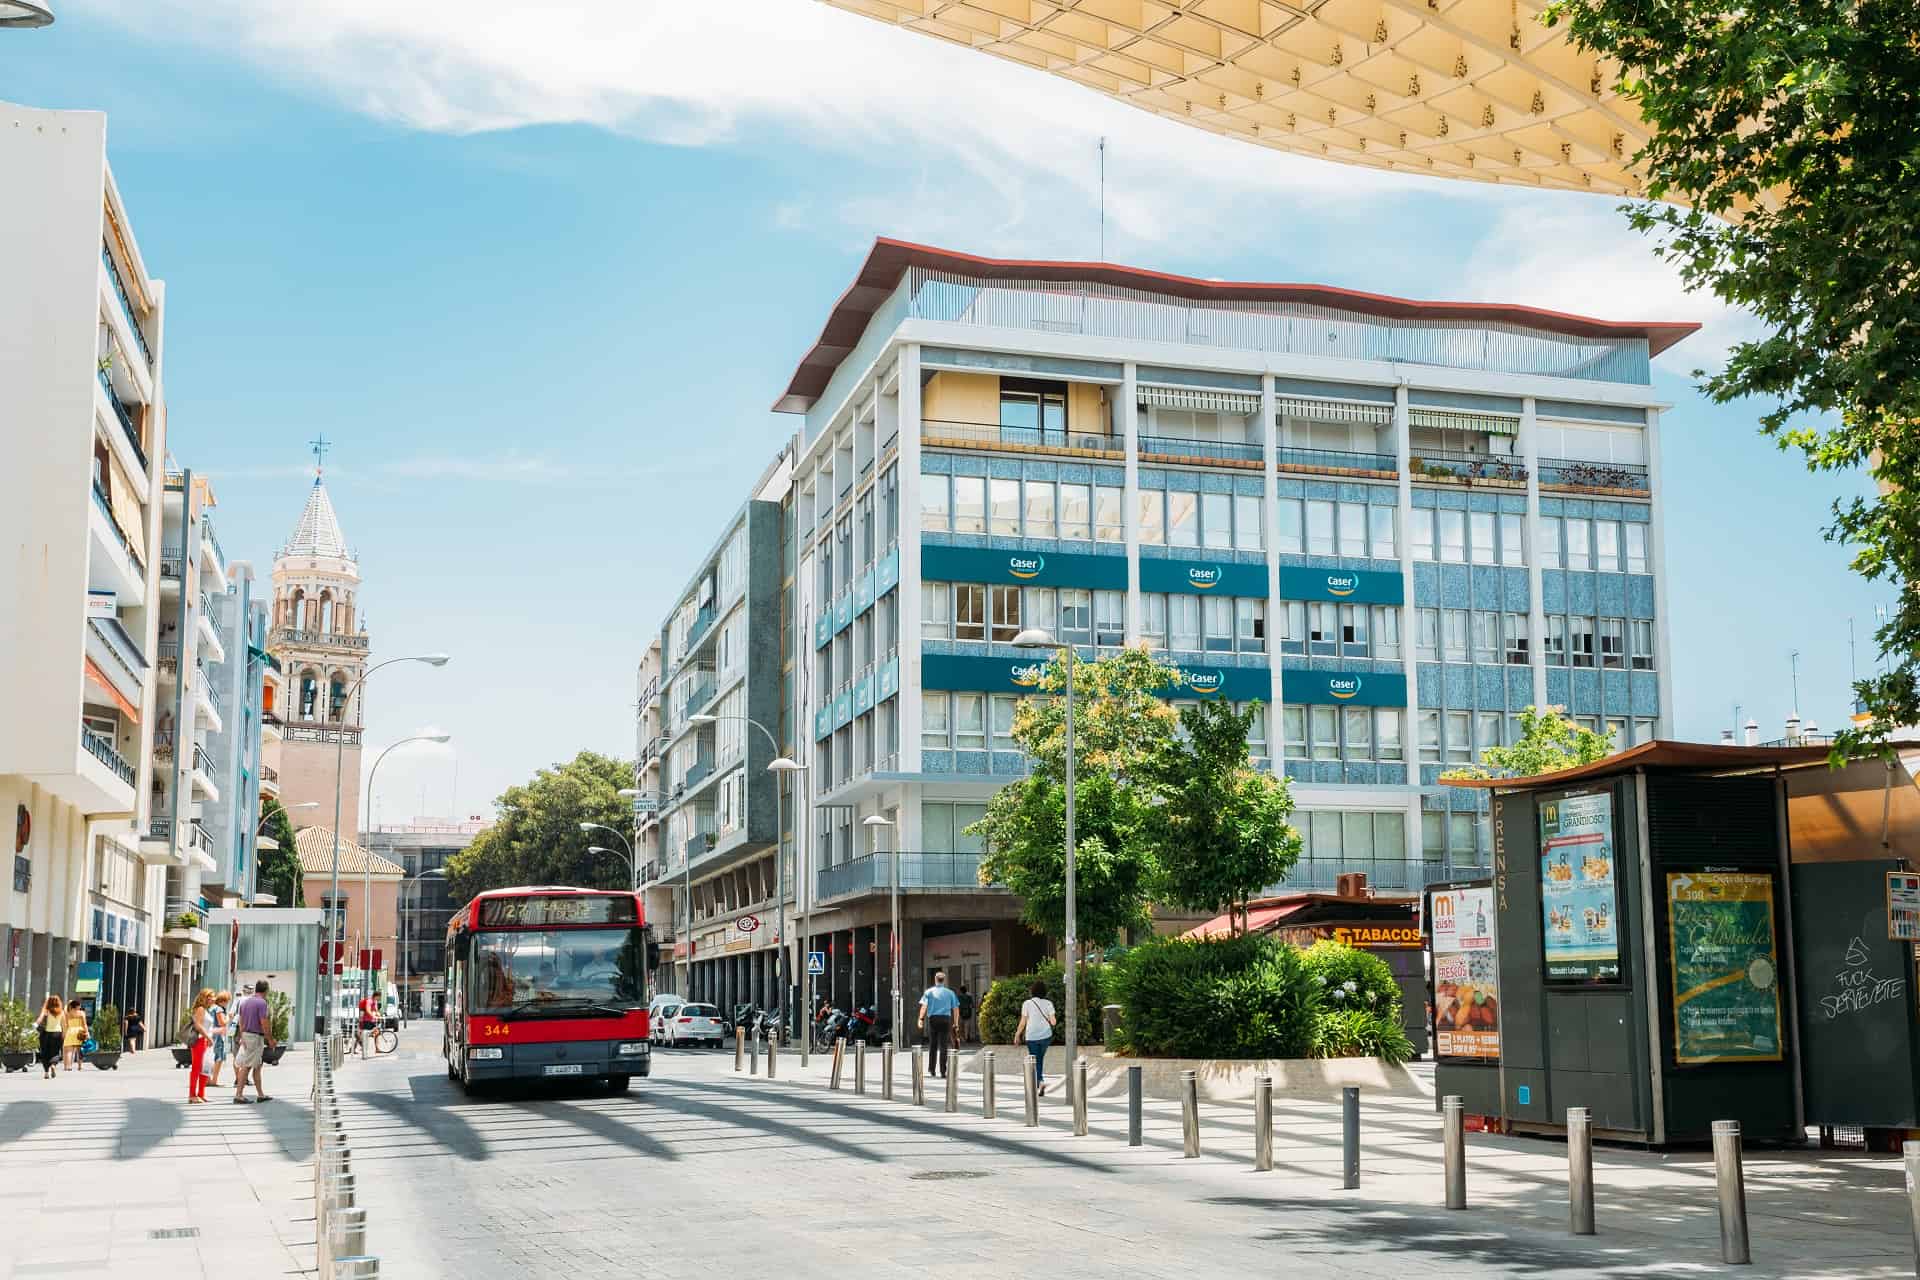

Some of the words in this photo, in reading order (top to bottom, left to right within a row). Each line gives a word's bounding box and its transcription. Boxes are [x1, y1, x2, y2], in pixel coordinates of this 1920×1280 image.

[1010, 557, 1037, 569] Caser
[1189, 568, 1215, 578] Caser
[1327, 576, 1352, 586] Caser
[1191, 673, 1217, 683] Caser
[1330, 679, 1355, 689] Caser
[1494, 800, 1508, 912] PRENSA
[1352, 928, 1421, 941] TABACOS
[1836, 968, 1878, 987] FUCK
[485, 1024, 509, 1036] 344
